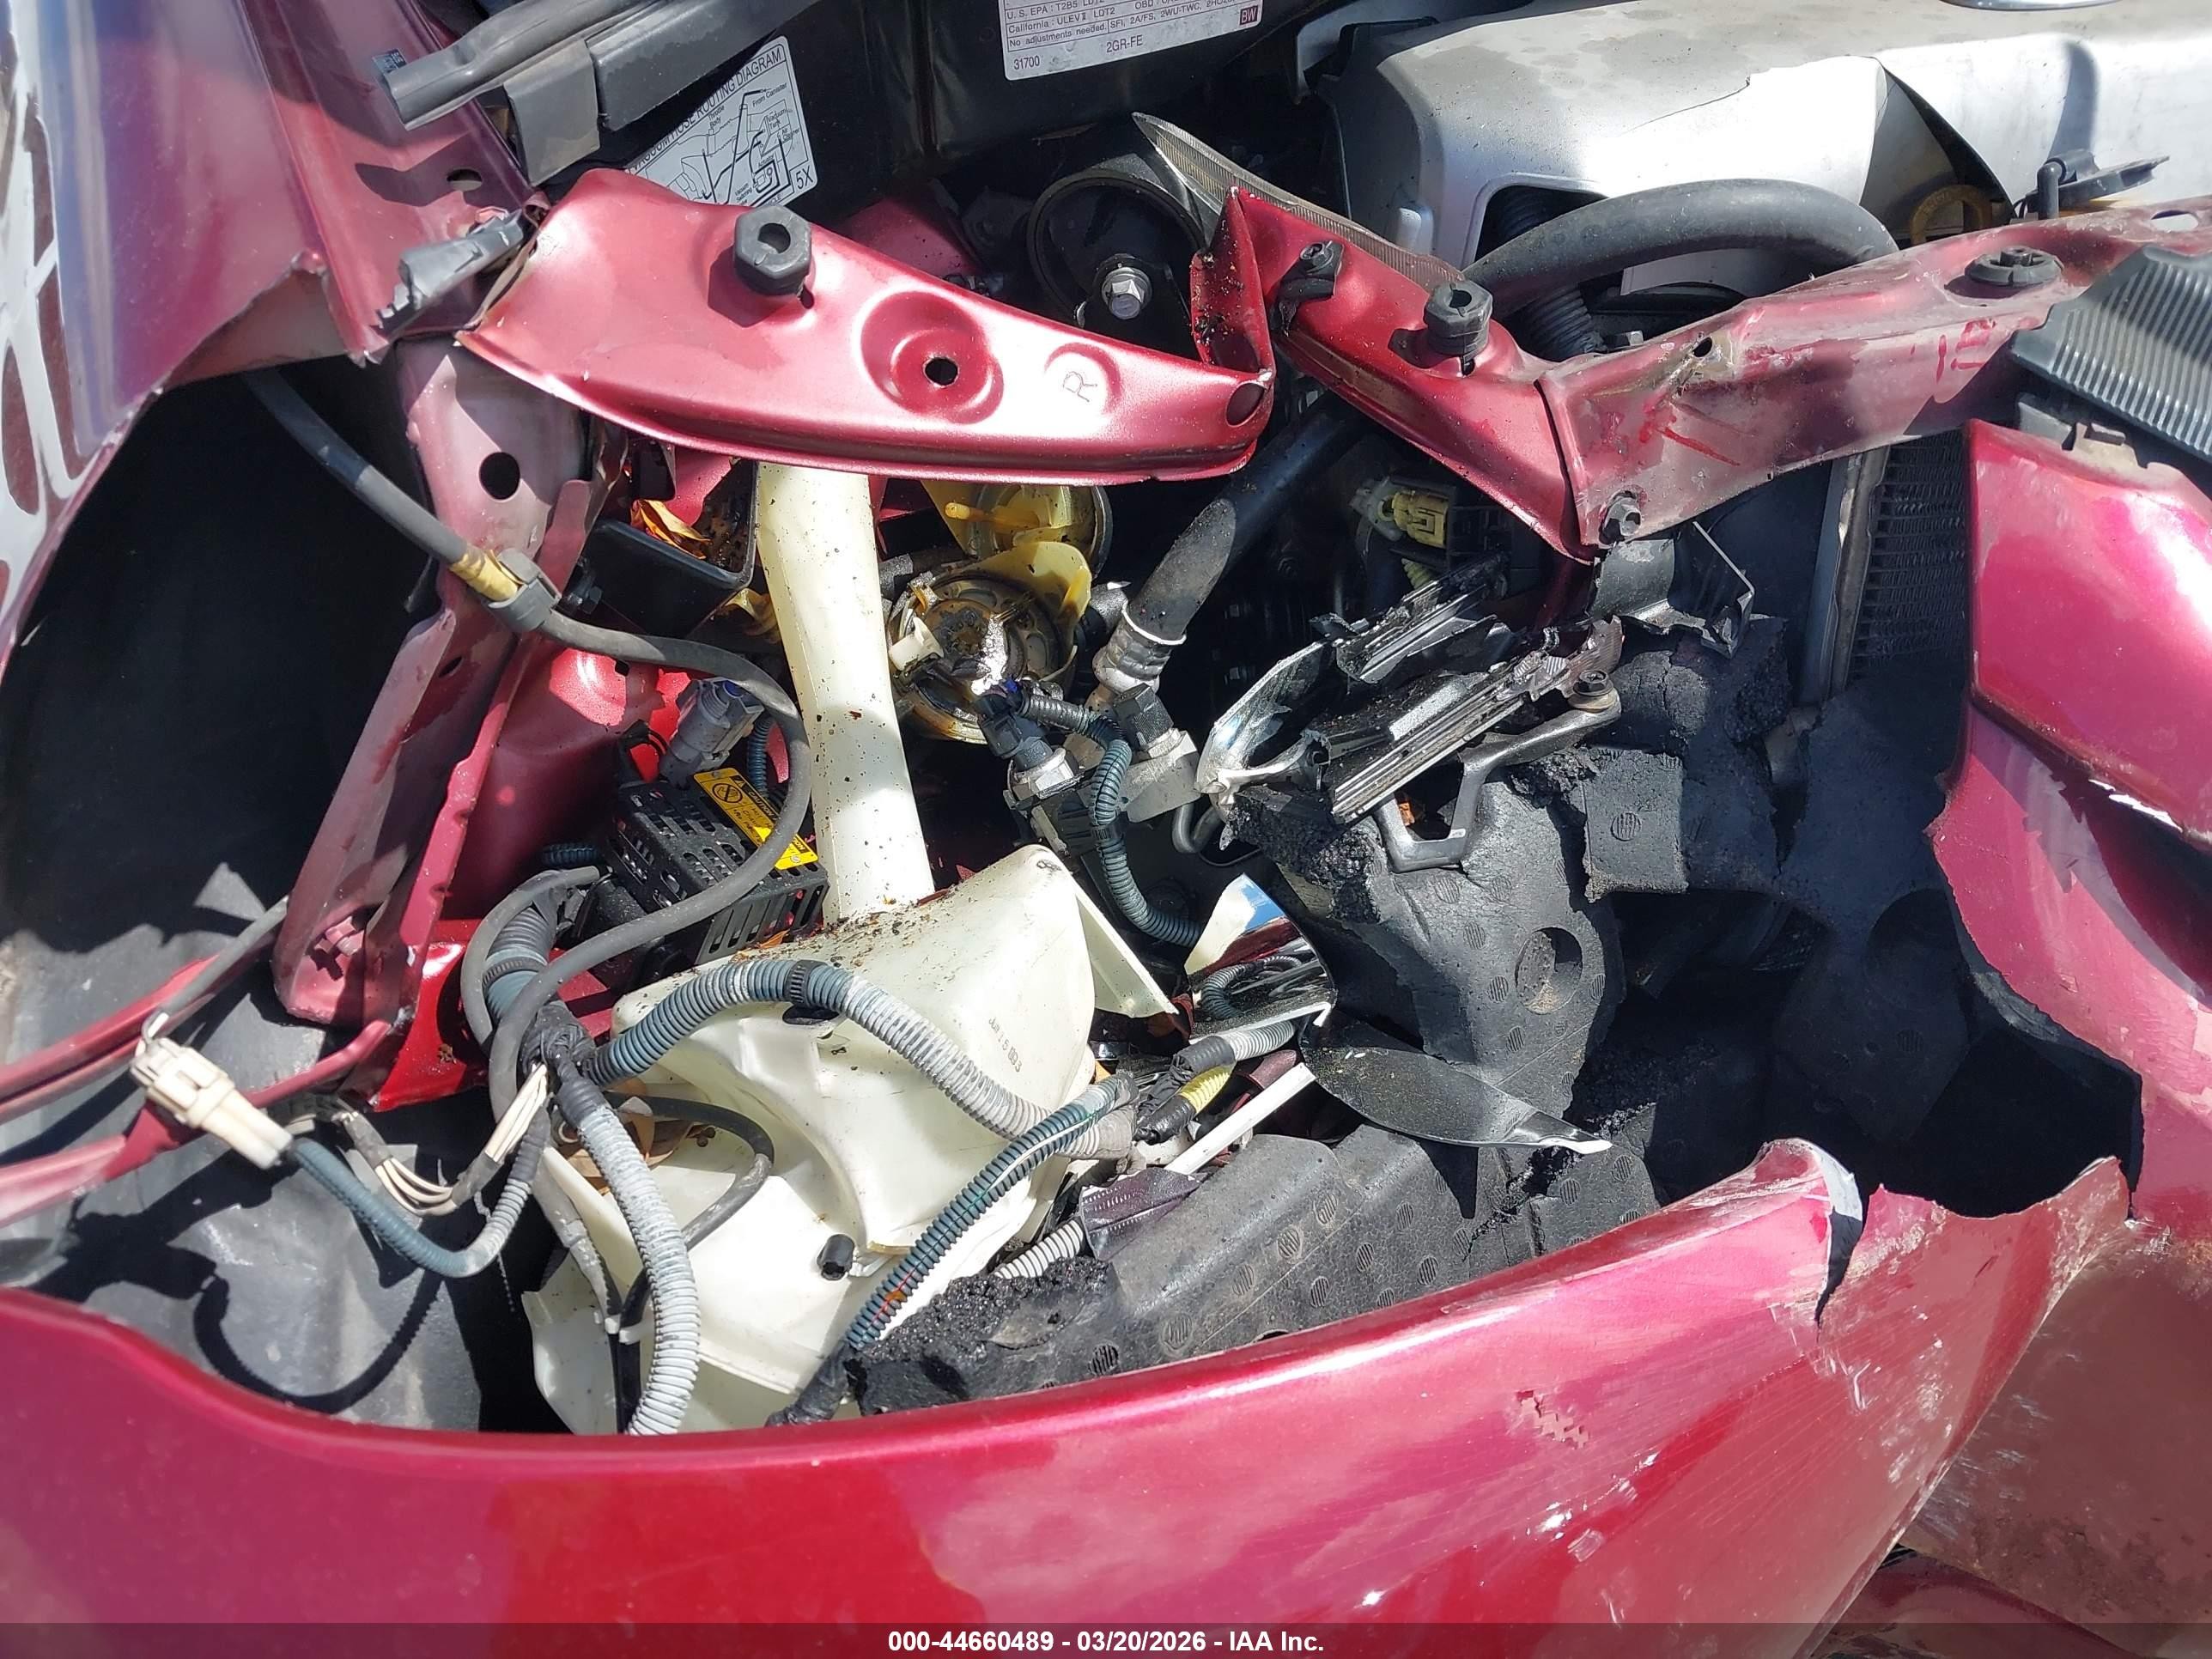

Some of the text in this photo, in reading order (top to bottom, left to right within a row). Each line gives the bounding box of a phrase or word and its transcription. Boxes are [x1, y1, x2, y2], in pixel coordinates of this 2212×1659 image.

[1008, 21, 1049, 33] California
[1093, 7, 1115, 18] LDT2
[1241, 7, 1256, 21] BW
[1009, 23, 1107, 48] No adjustments needed.
[1106, 35, 1144, 53] 2GR-FE
[736, 47, 782, 86] DIAGRAM
[1013, 55, 1040, 70] 31700
[752, 95, 766, 108] From
[795, 165, 813, 190] 5X
[747, 790, 774, 817] CAUTION
